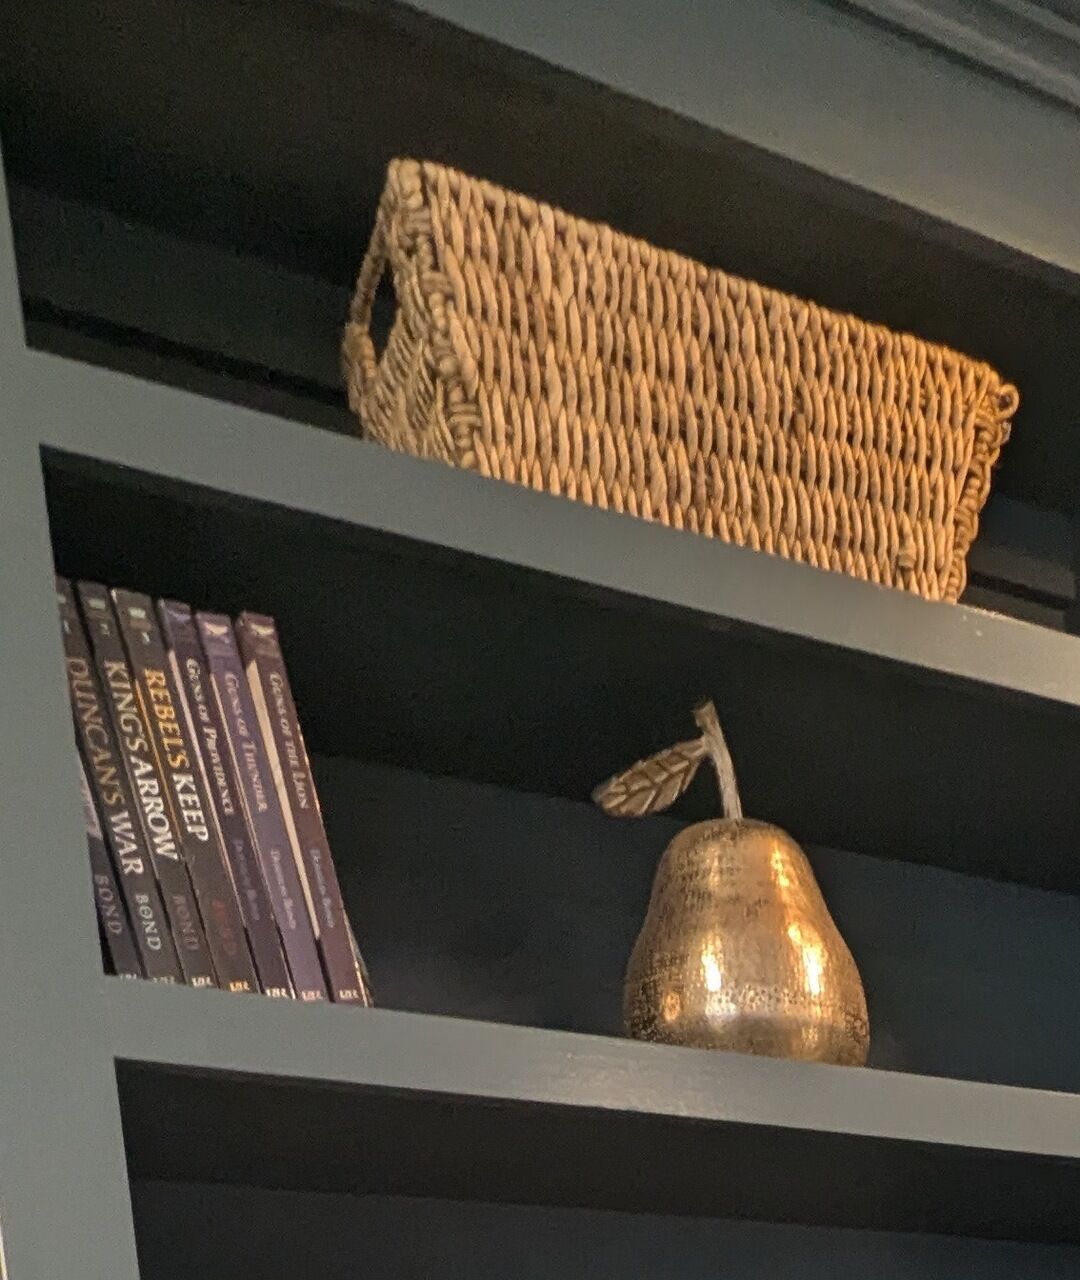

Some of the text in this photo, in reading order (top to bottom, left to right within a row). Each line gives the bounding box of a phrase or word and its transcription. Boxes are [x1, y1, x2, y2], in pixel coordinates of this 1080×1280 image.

[67, 658, 144, 875] DUNCAN'S WAR
[129, 755, 179, 861] ARROW
[172, 773, 209, 842] KEEP
[135, 894, 162, 951] BOND
